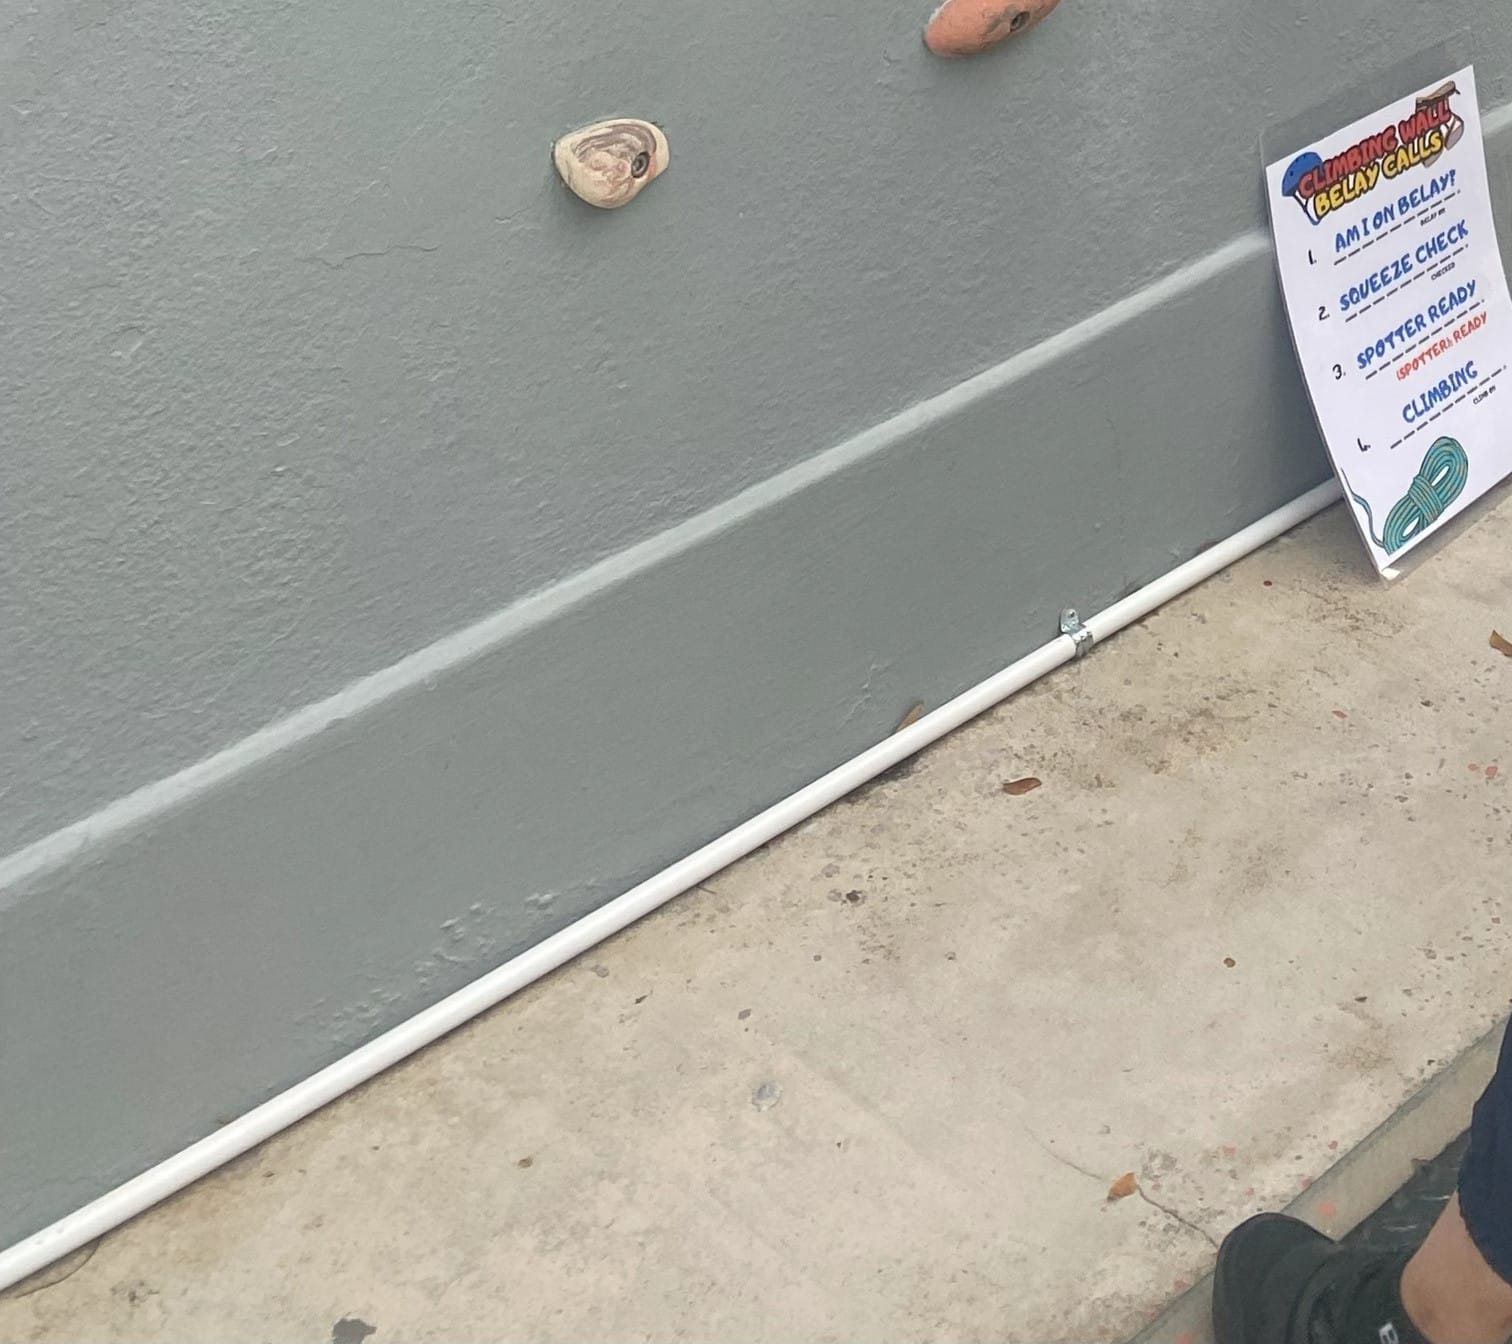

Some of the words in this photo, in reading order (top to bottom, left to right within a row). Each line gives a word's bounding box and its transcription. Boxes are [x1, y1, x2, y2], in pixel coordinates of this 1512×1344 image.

[1297, 124, 1398, 199] CLIMBING
[1398, 97, 1452, 142] WALL
[1313, 161, 1380, 218] BELAY
[1381, 129, 1444, 180] CALLS
[1335, 225, 1361, 253] AM
[1362, 217, 1370, 237] I
[1372, 204, 1395, 230] ON
[1397, 169, 1456, 216] BELAY?
[1318, 306, 1330, 321] 2.
[1340, 253, 1413, 311] SQUEEZE
[1415, 219, 1469, 264] CHECK
[1332, 363, 1346, 380] 3.
[1357, 318, 1427, 369] SPOTTER
[1428, 279, 1476, 323] READY
[1453, 311, 1487, 343] READY
[1402, 360, 1478, 423] CLIMBING
